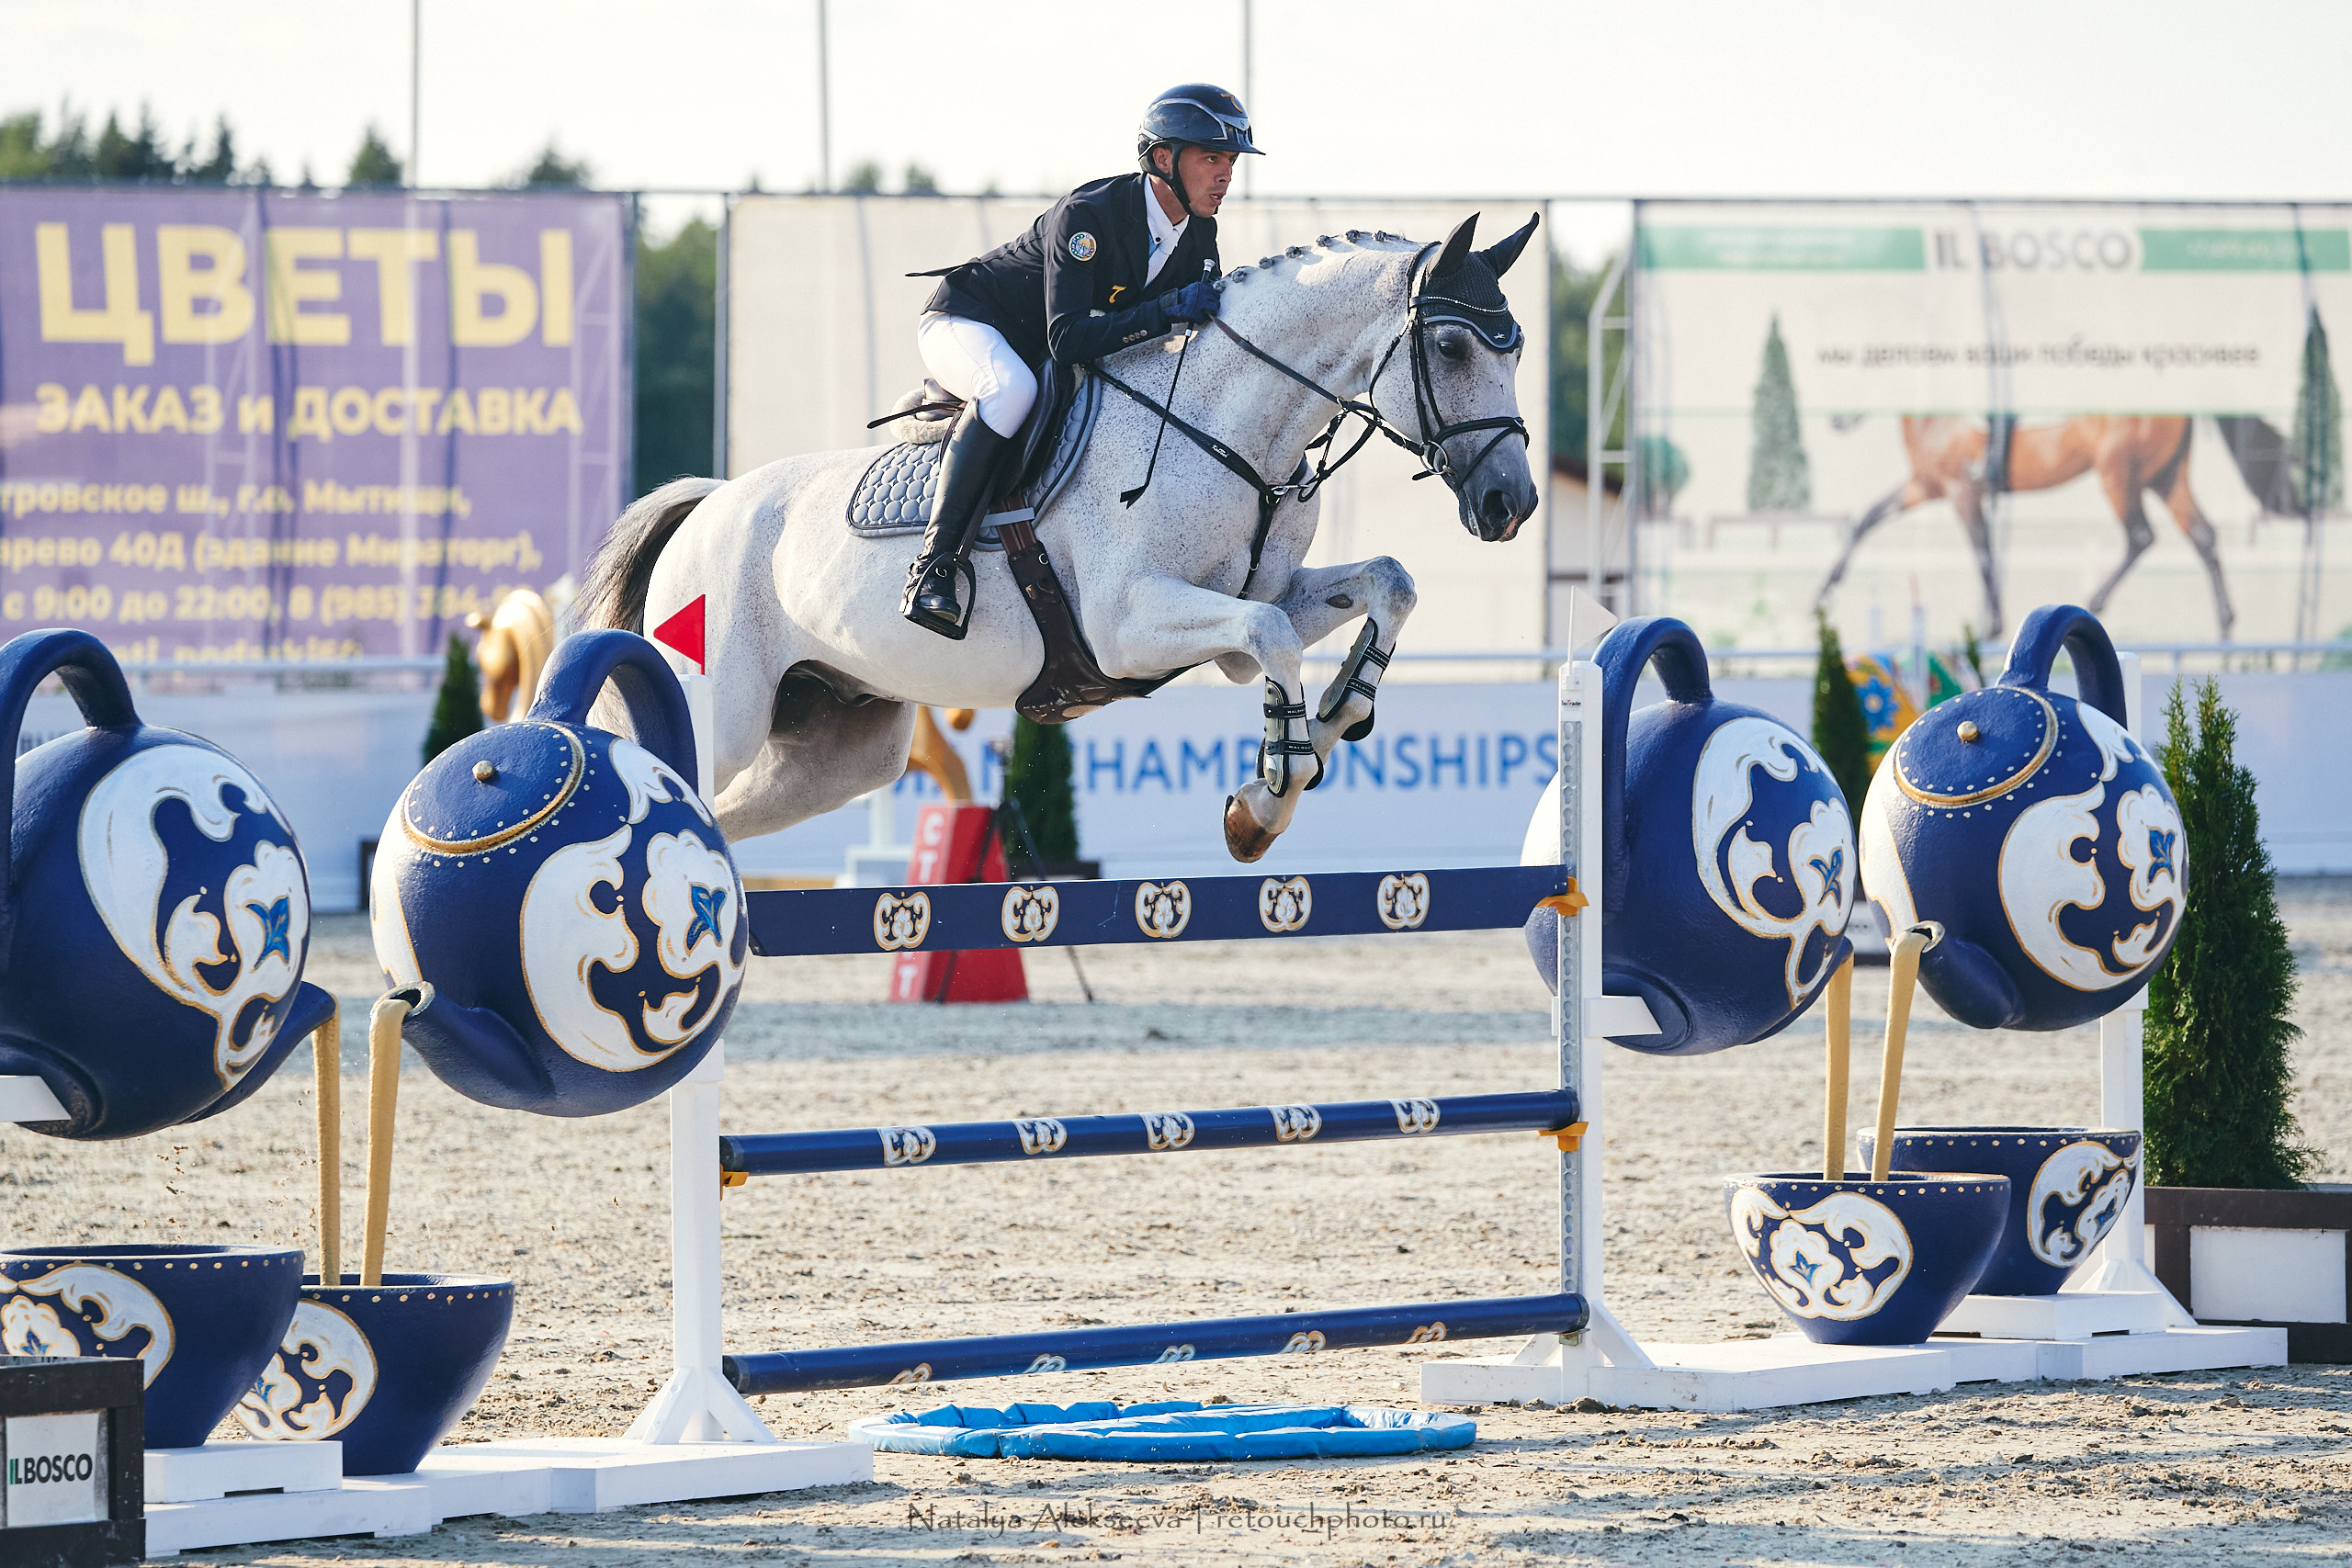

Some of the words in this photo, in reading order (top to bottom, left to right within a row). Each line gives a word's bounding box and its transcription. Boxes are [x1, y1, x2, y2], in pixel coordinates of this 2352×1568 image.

[1934, 230, 1970, 270] IL
[1984, 230, 2132, 270] BOSCO
[35, 221, 576, 367] ЦВЕТЫ
[34, 383, 225, 434] ЗАКАЗ
[237, 392, 275, 434] и
[286, 387, 584, 444] ДОСТАВКА
[108, 530, 187, 573] 40Д
[33, 584, 113, 622] 9:00
[118, 590, 169, 626] до
[288, 583, 314, 622] 8
